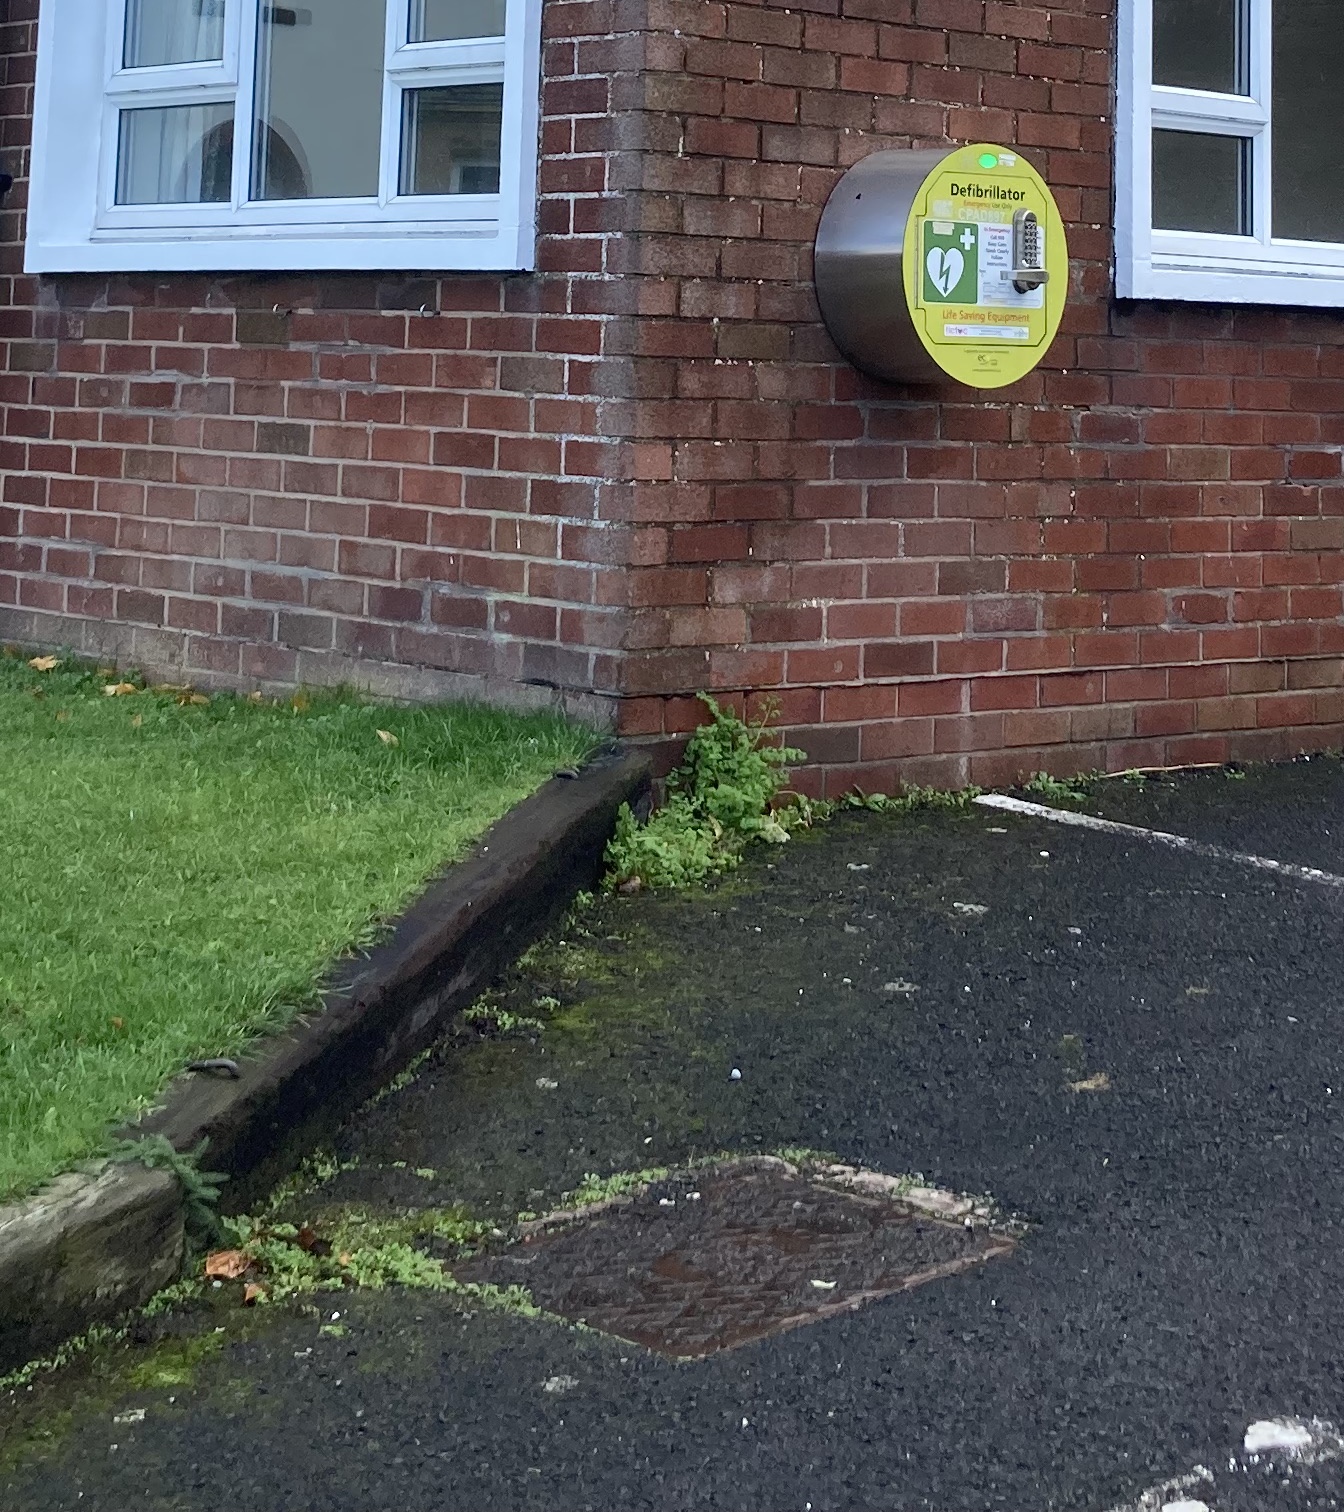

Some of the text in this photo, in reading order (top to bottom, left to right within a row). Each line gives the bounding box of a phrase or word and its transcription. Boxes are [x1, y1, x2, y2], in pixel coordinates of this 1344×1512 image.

[950, 183, 1026, 202] Defibrillator
[963, 199, 991, 209] Emergency
[942, 309, 1030, 324] Life Saving Equipment
